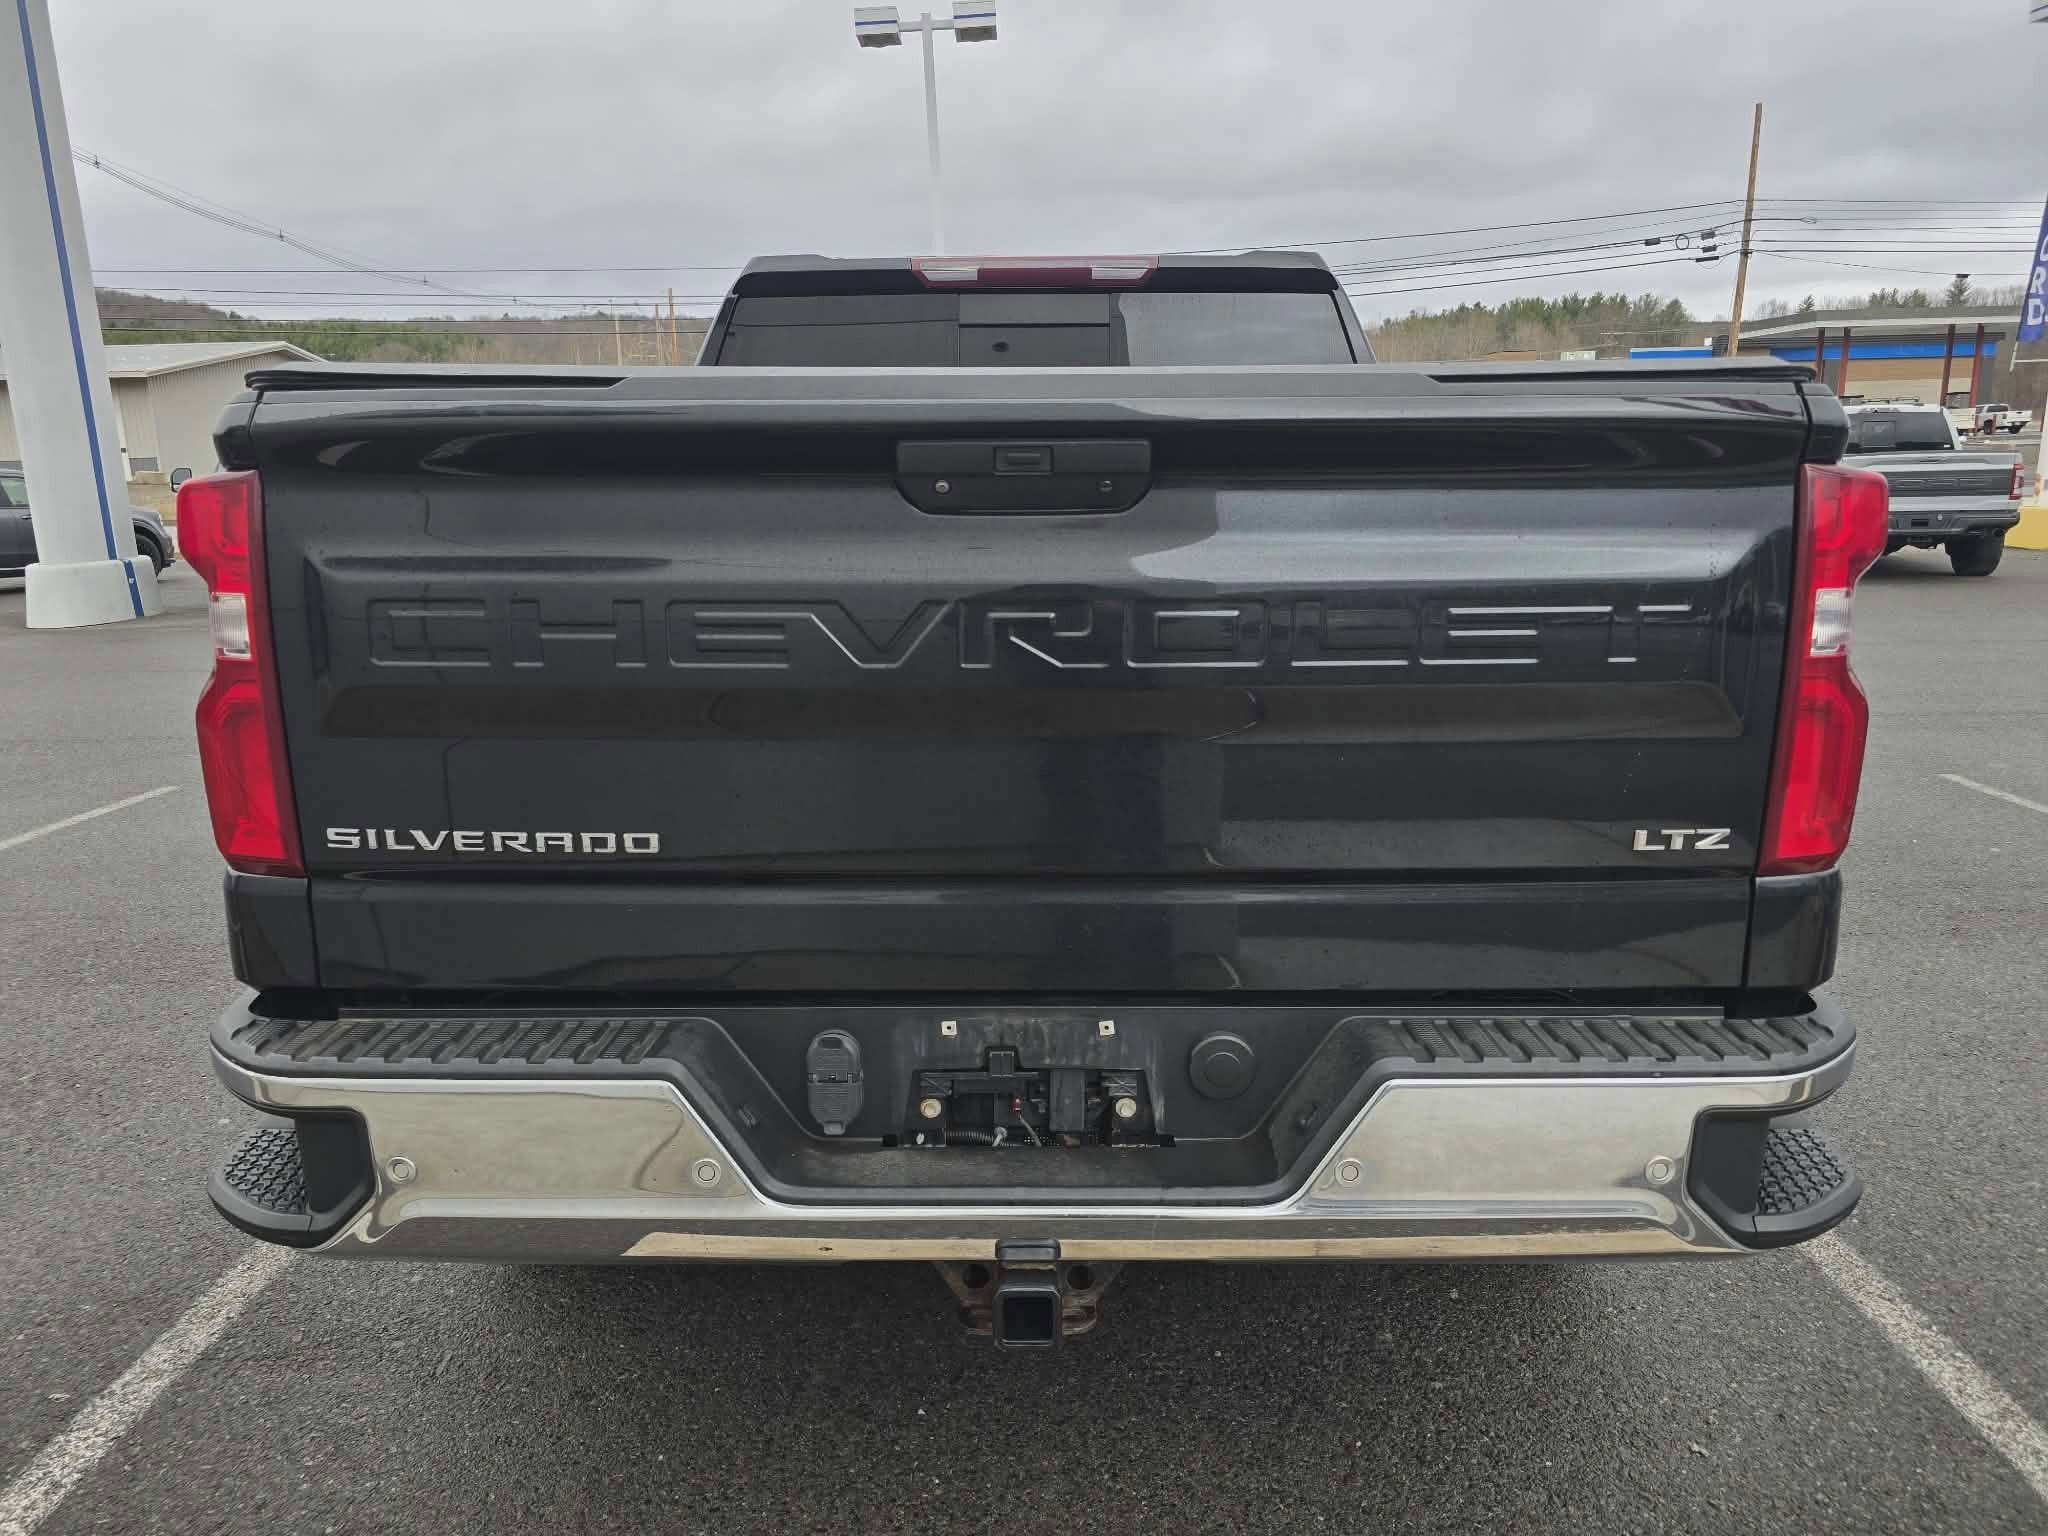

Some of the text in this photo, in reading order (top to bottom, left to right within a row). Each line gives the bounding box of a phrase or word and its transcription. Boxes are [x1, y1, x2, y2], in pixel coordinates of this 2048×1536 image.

[367, 596, 1692, 669] CHEVROLET
[326, 827, 661, 854] SILVERADO
[1632, 828, 1731, 851] LTZ
